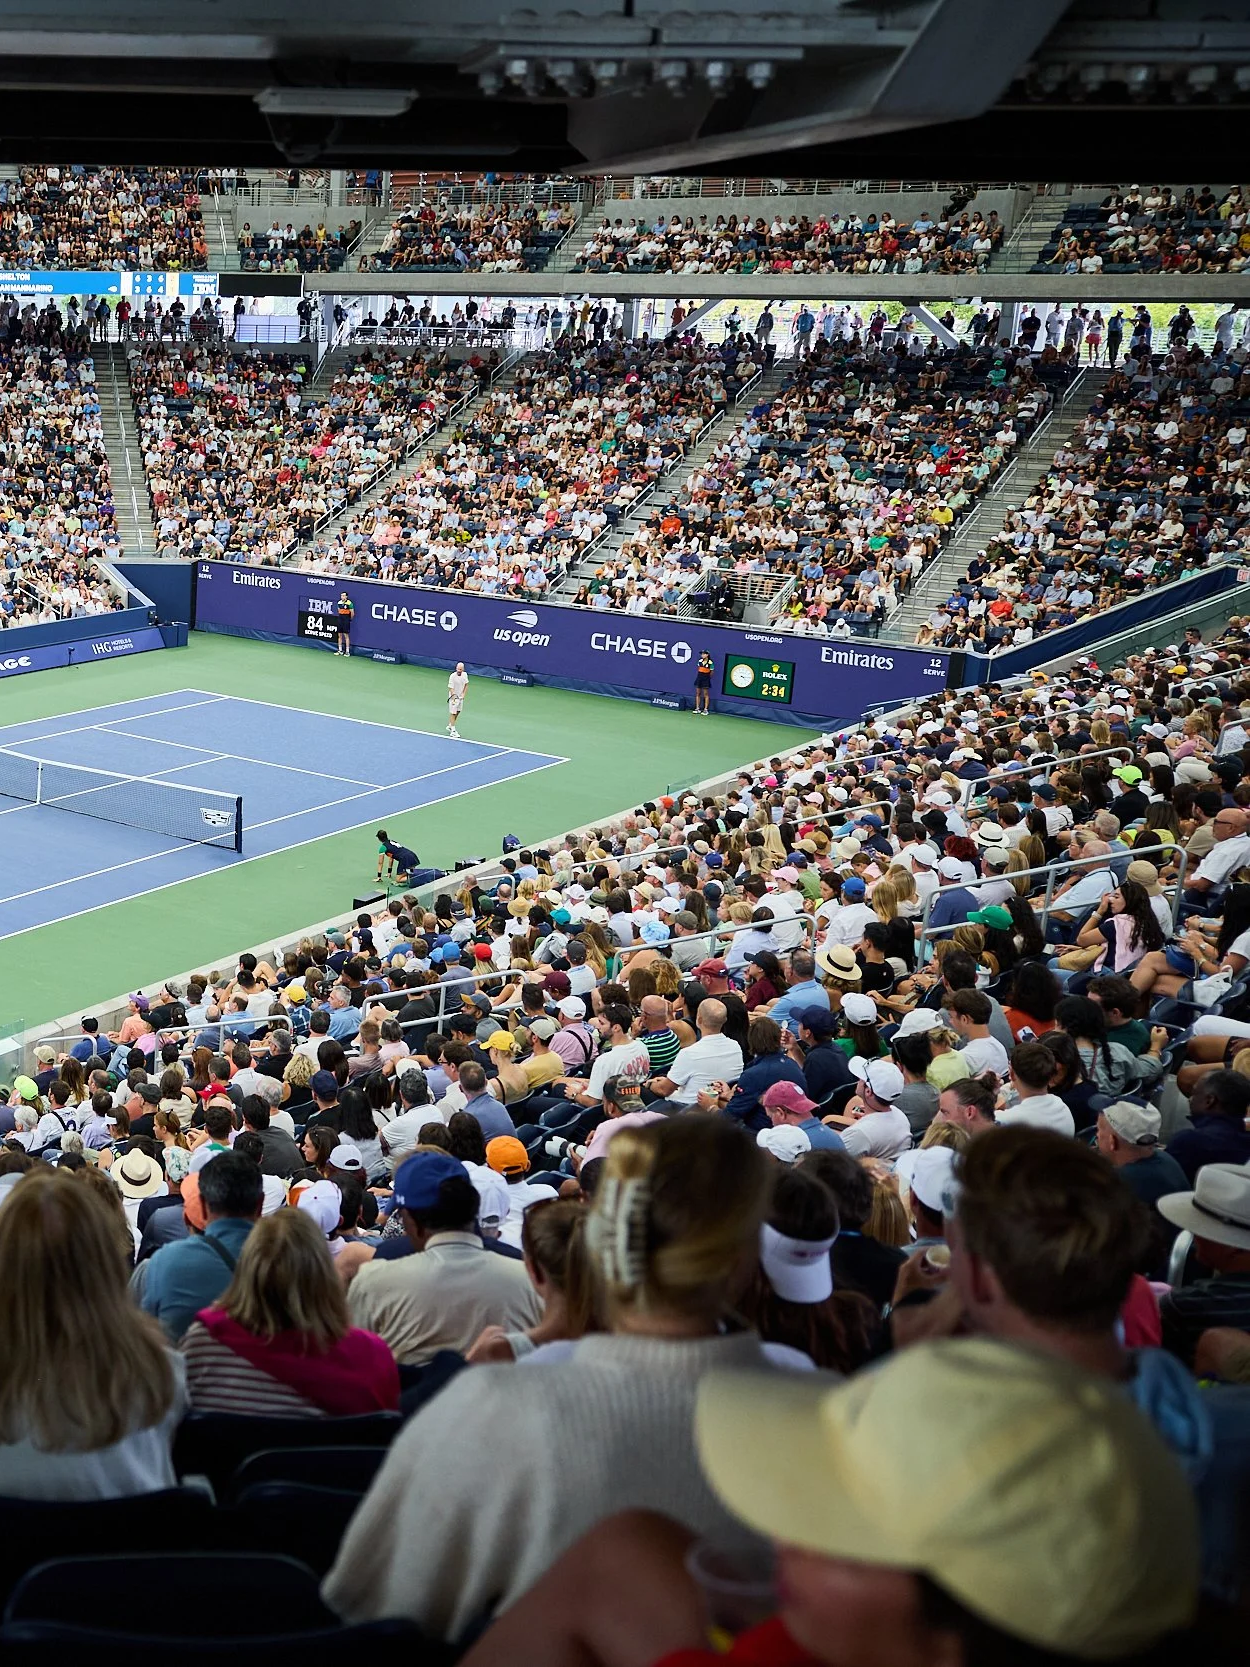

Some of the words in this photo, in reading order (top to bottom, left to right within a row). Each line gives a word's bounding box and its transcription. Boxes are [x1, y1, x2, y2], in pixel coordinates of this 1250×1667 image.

[135, 274, 141, 282] 6
[158, 274, 164, 282] 6
[10, 284, 54, 292] MANNARINO
[192, 283, 216, 294] IBM
[202, 565, 210, 573] 12
[232, 570, 281, 589] Emirates
[308, 598, 333, 614] IBM
[371, 603, 437, 627] CHASE
[306, 615, 324, 631] 84
[304, 629, 318, 637] SERVE
[319, 631, 333, 639] SPEED
[512, 630, 550, 647] open
[745, 633, 783, 644] USOPEN.ORG
[92, 640, 112, 655] IHG
[112, 643, 134, 651] RESORTS
[590, 632, 668, 659] CHASE
[821, 646, 894, 670] Emirates
[930, 658, 942, 668] 12
[762, 671, 788, 681] ROLEX
[923, 668, 946, 677] SERVE
[761, 683, 785, 698] 2:34
